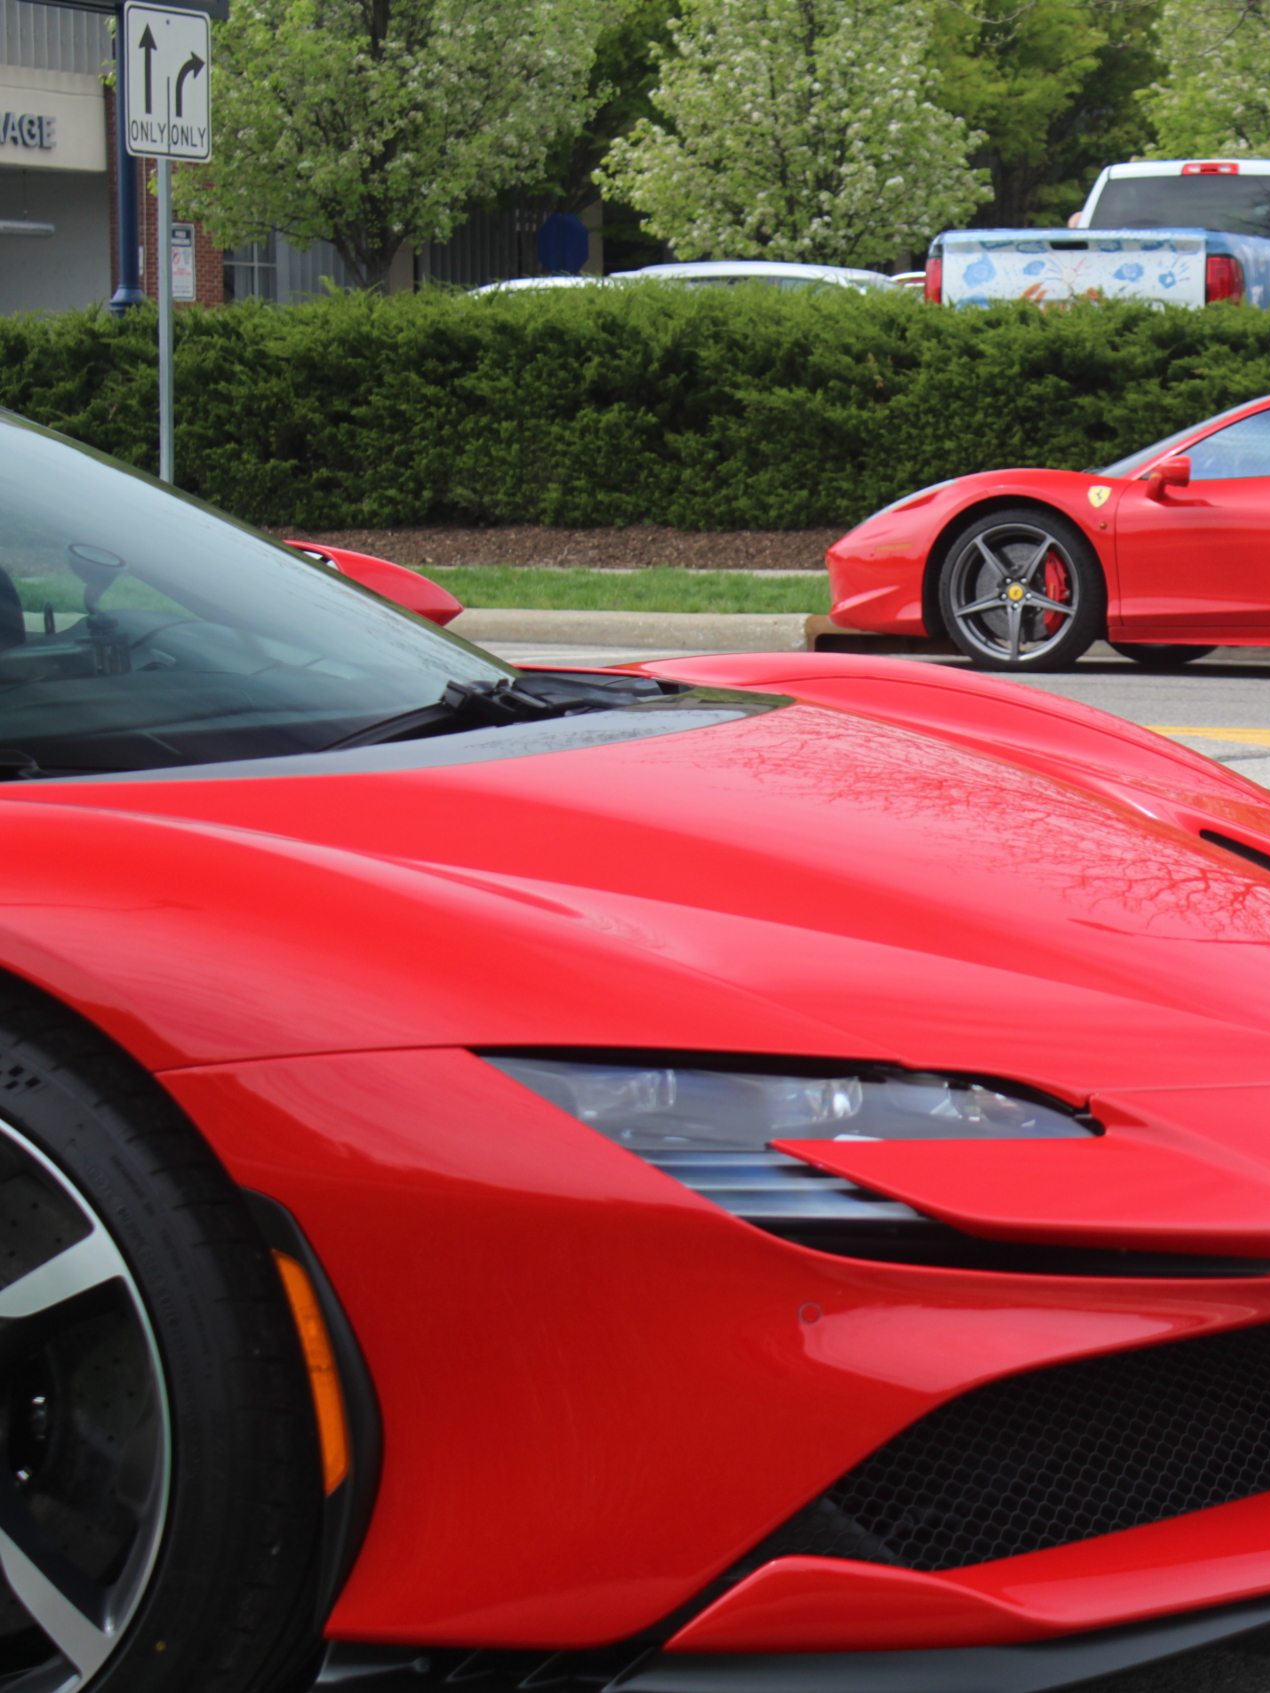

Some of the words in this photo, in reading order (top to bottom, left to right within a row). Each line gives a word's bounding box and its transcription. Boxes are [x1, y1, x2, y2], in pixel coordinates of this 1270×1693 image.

[0, 111, 57, 151] AGE
[131, 120, 166, 144] ONLY
[171, 124, 206, 149] ONLY
